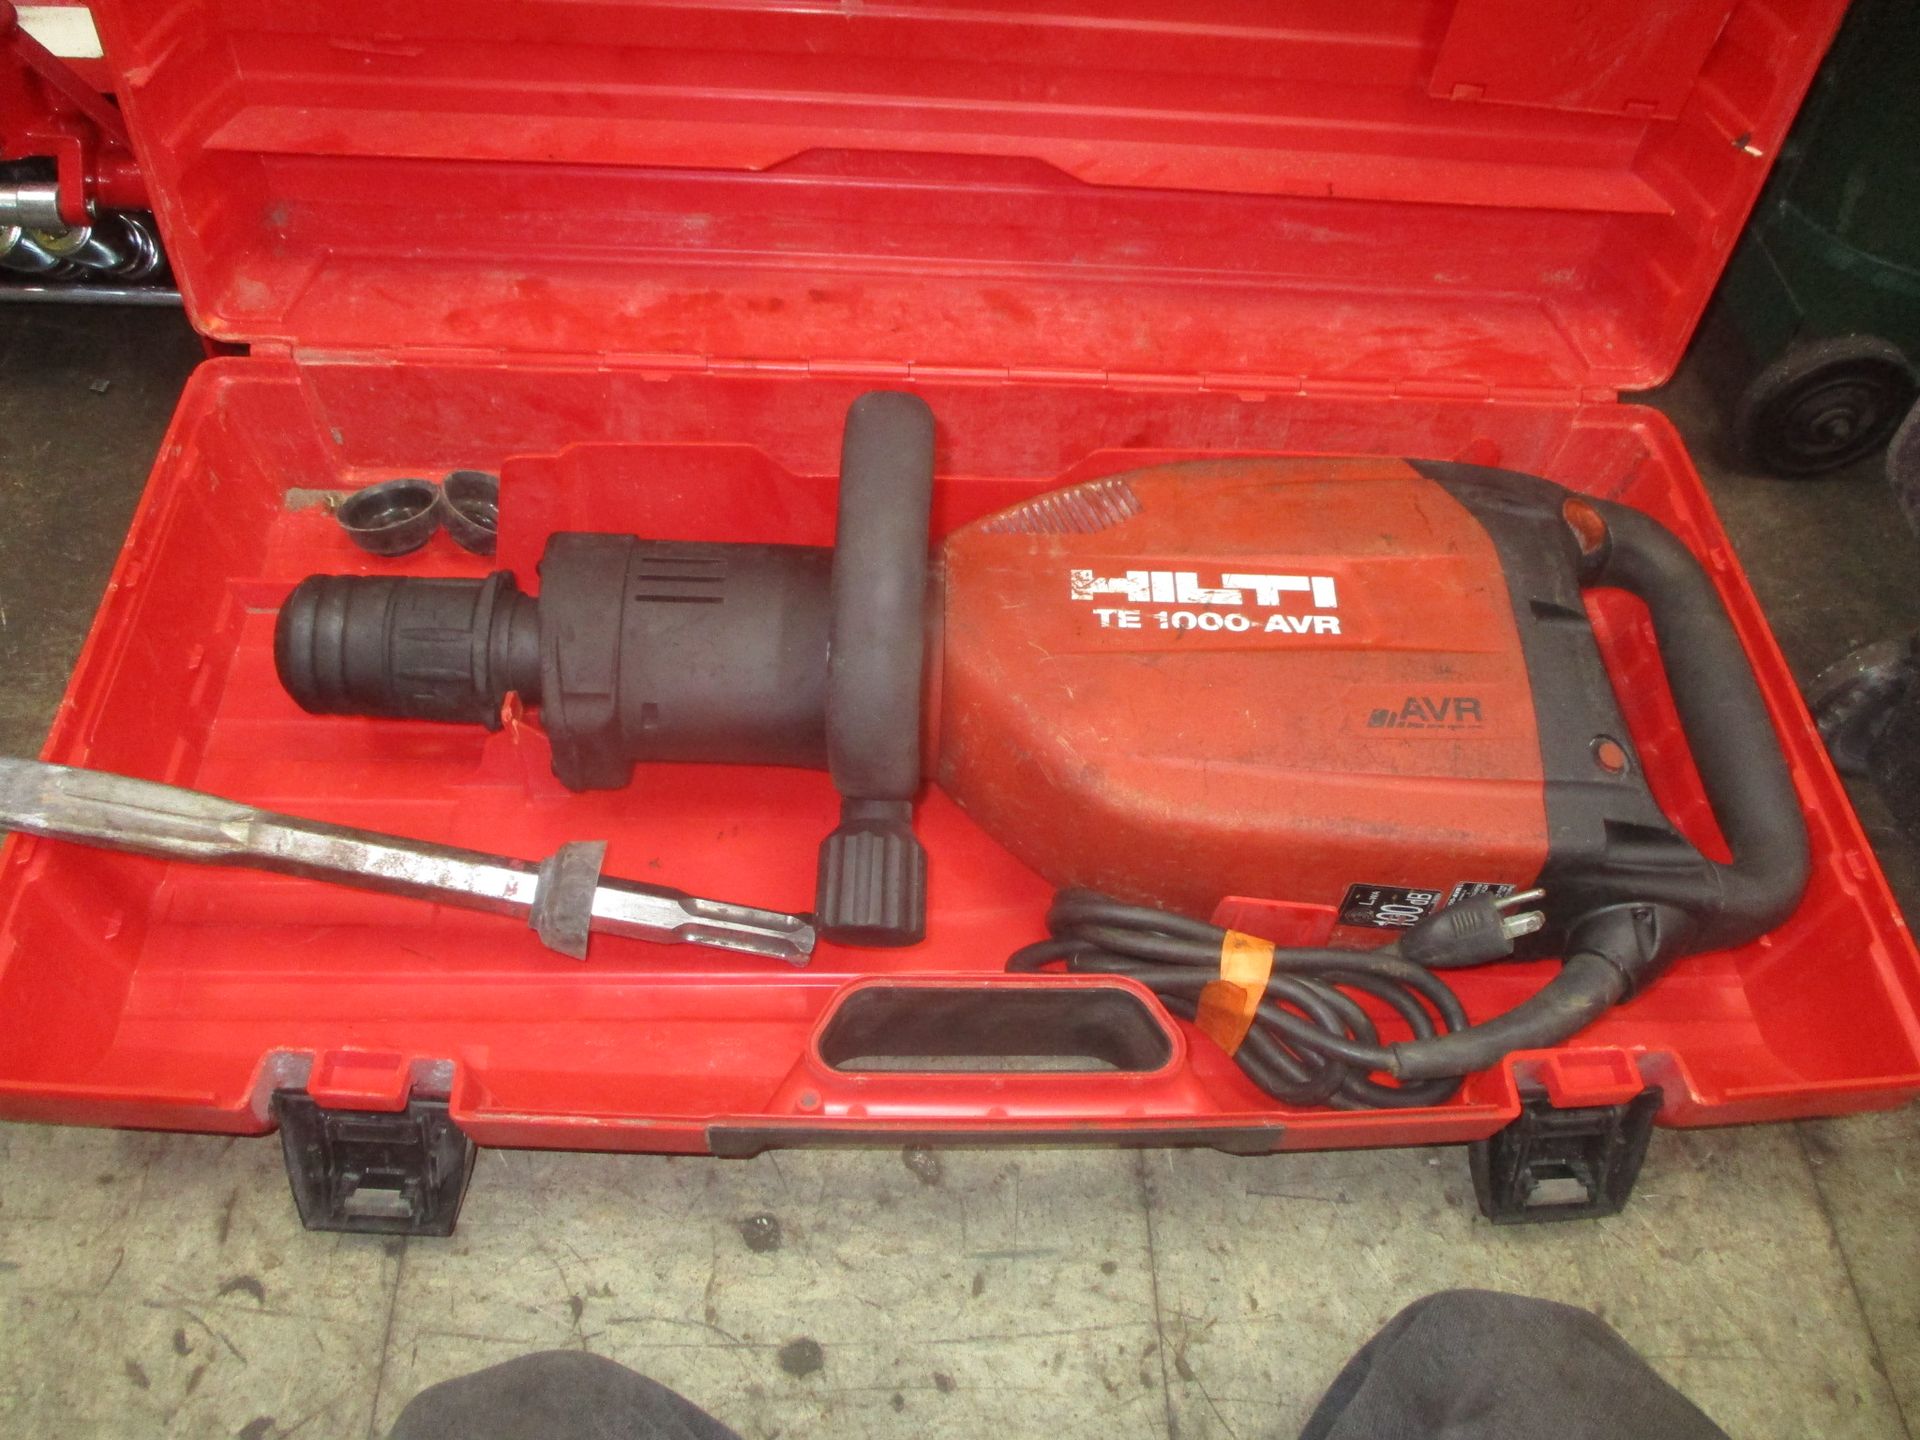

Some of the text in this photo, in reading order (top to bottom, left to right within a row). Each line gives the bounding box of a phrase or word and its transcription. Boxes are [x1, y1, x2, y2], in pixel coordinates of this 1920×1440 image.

[1070, 569, 1338, 609] HILTI
[1092, 608, 1142, 629] TE
[1400, 697, 1483, 722] AVR
[1405, 892, 1433, 906] dB
